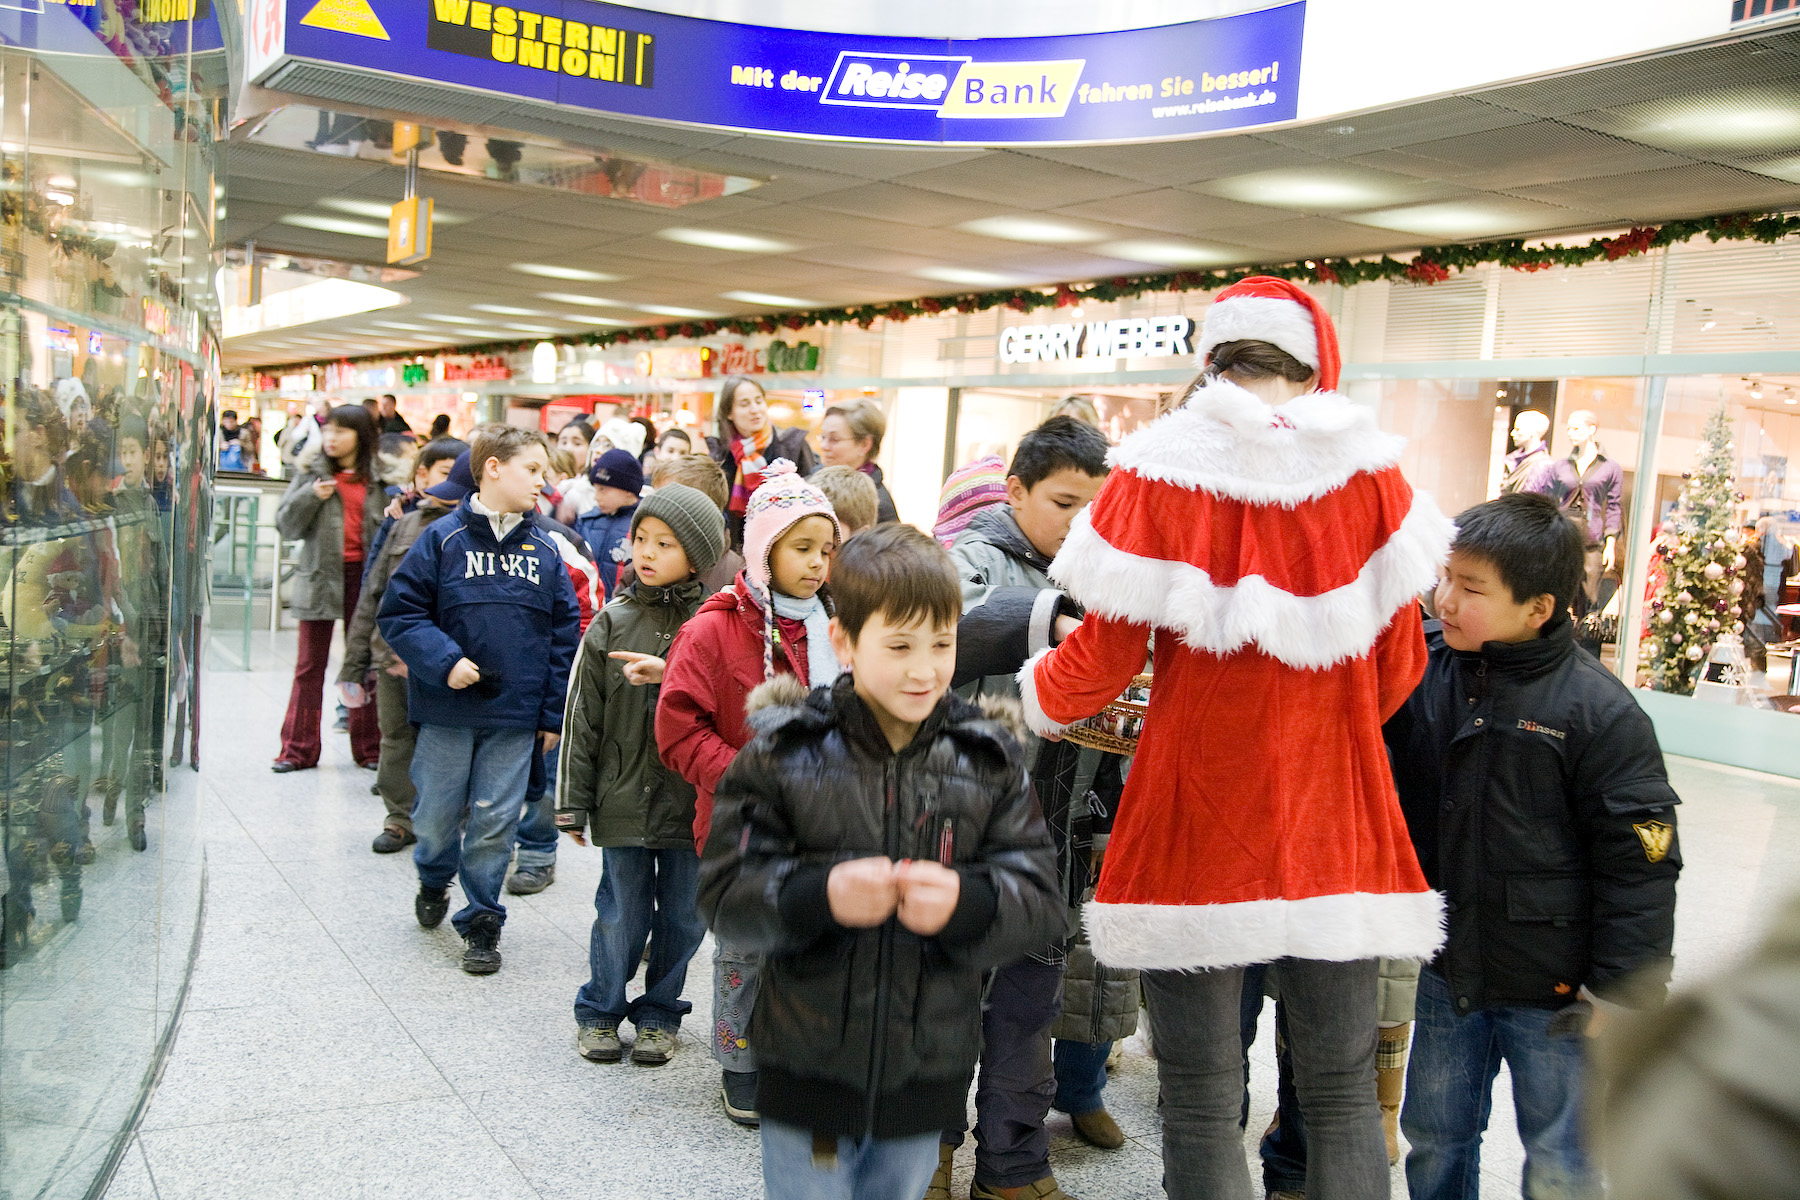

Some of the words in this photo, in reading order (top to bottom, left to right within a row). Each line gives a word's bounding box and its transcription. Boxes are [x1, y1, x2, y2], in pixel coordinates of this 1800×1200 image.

[434, 0, 617, 55] WESTERN
[491, 32, 616, 82] UNION
[731, 65, 774, 88] Mit
[780, 69, 823, 92] der
[838, 62, 948, 100] Reise
[964, 75, 1057, 106] Bank
[1078, 82, 1152, 105] fahren
[1160, 75, 1194, 98] Sie
[1201, 61, 1279, 93] besser!
[1151, 89, 1277, 119] www.reisebank.de
[1000, 324, 1085, 364] GERRY
[1085, 315, 1195, 357] WEBER
[464, 550, 540, 586] NIKE
